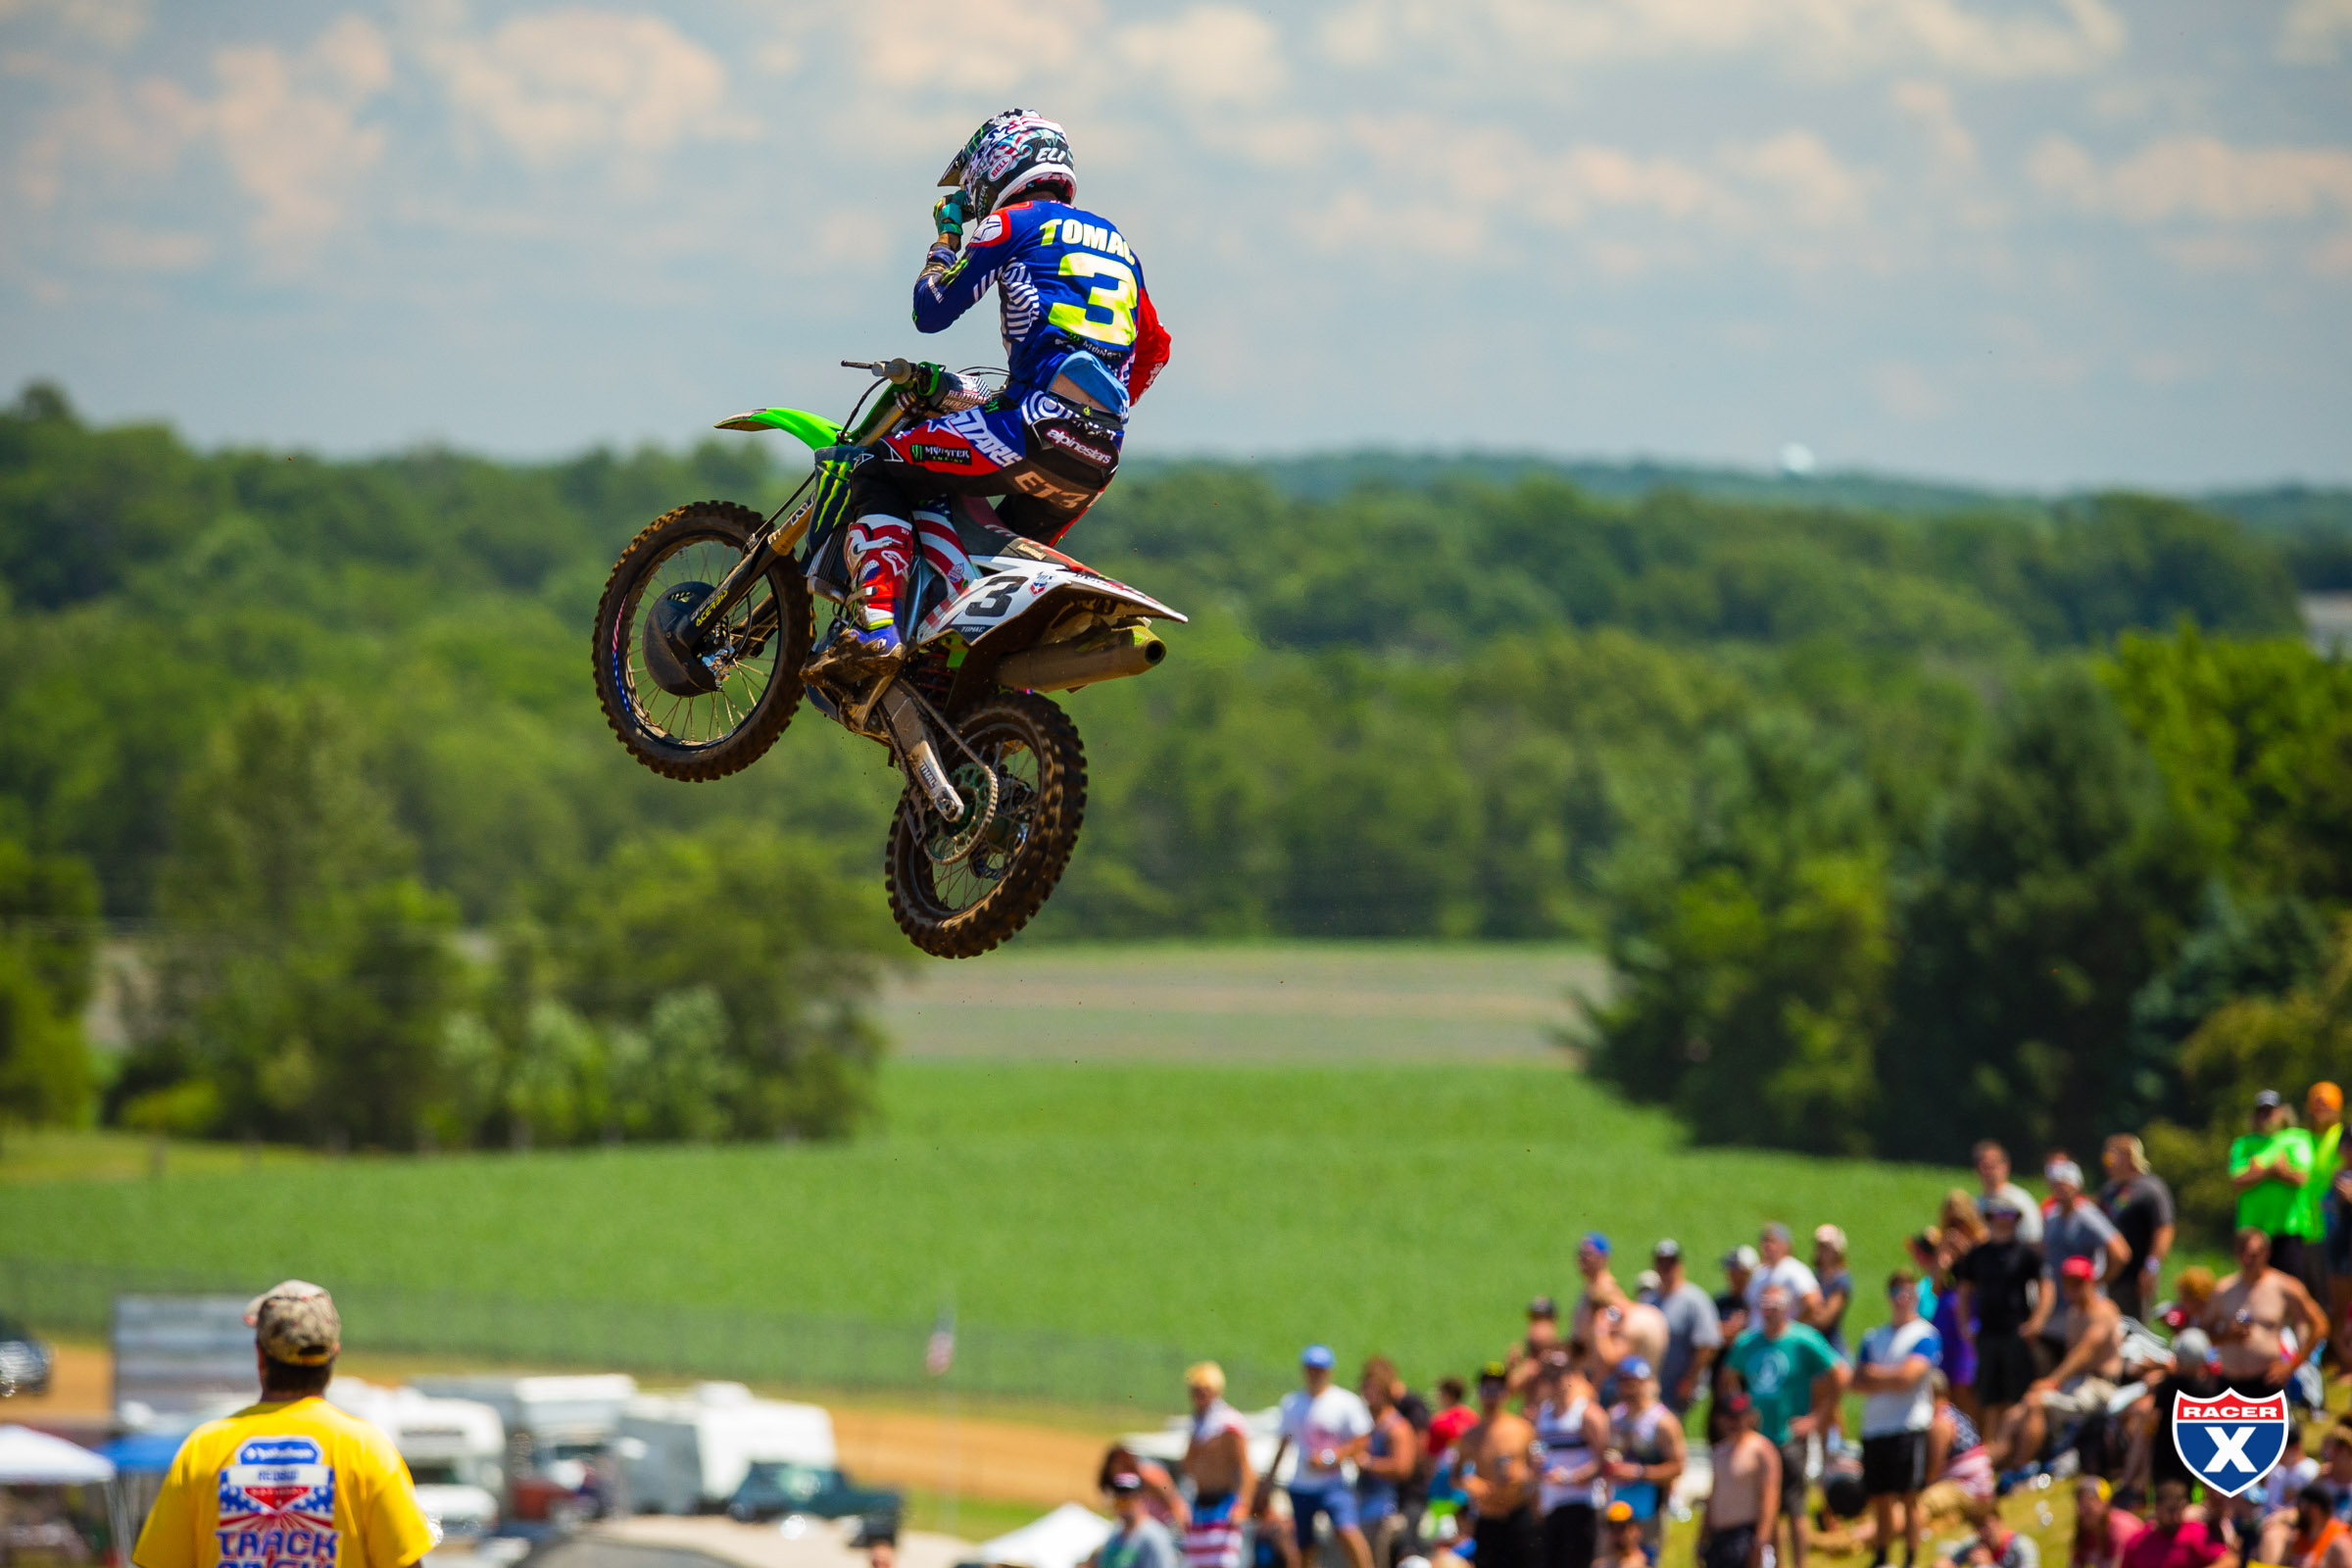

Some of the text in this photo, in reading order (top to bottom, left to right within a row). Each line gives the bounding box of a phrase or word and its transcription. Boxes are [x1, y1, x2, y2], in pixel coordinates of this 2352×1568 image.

[990, 160, 1008, 178] BELL
[1035, 147, 1067, 163] ELI
[1048, 252, 1138, 346] 3
[1047, 428, 1112, 464] alpinestars
[964, 575, 1029, 617] 3
[215, 1530, 338, 1558] TRACK
